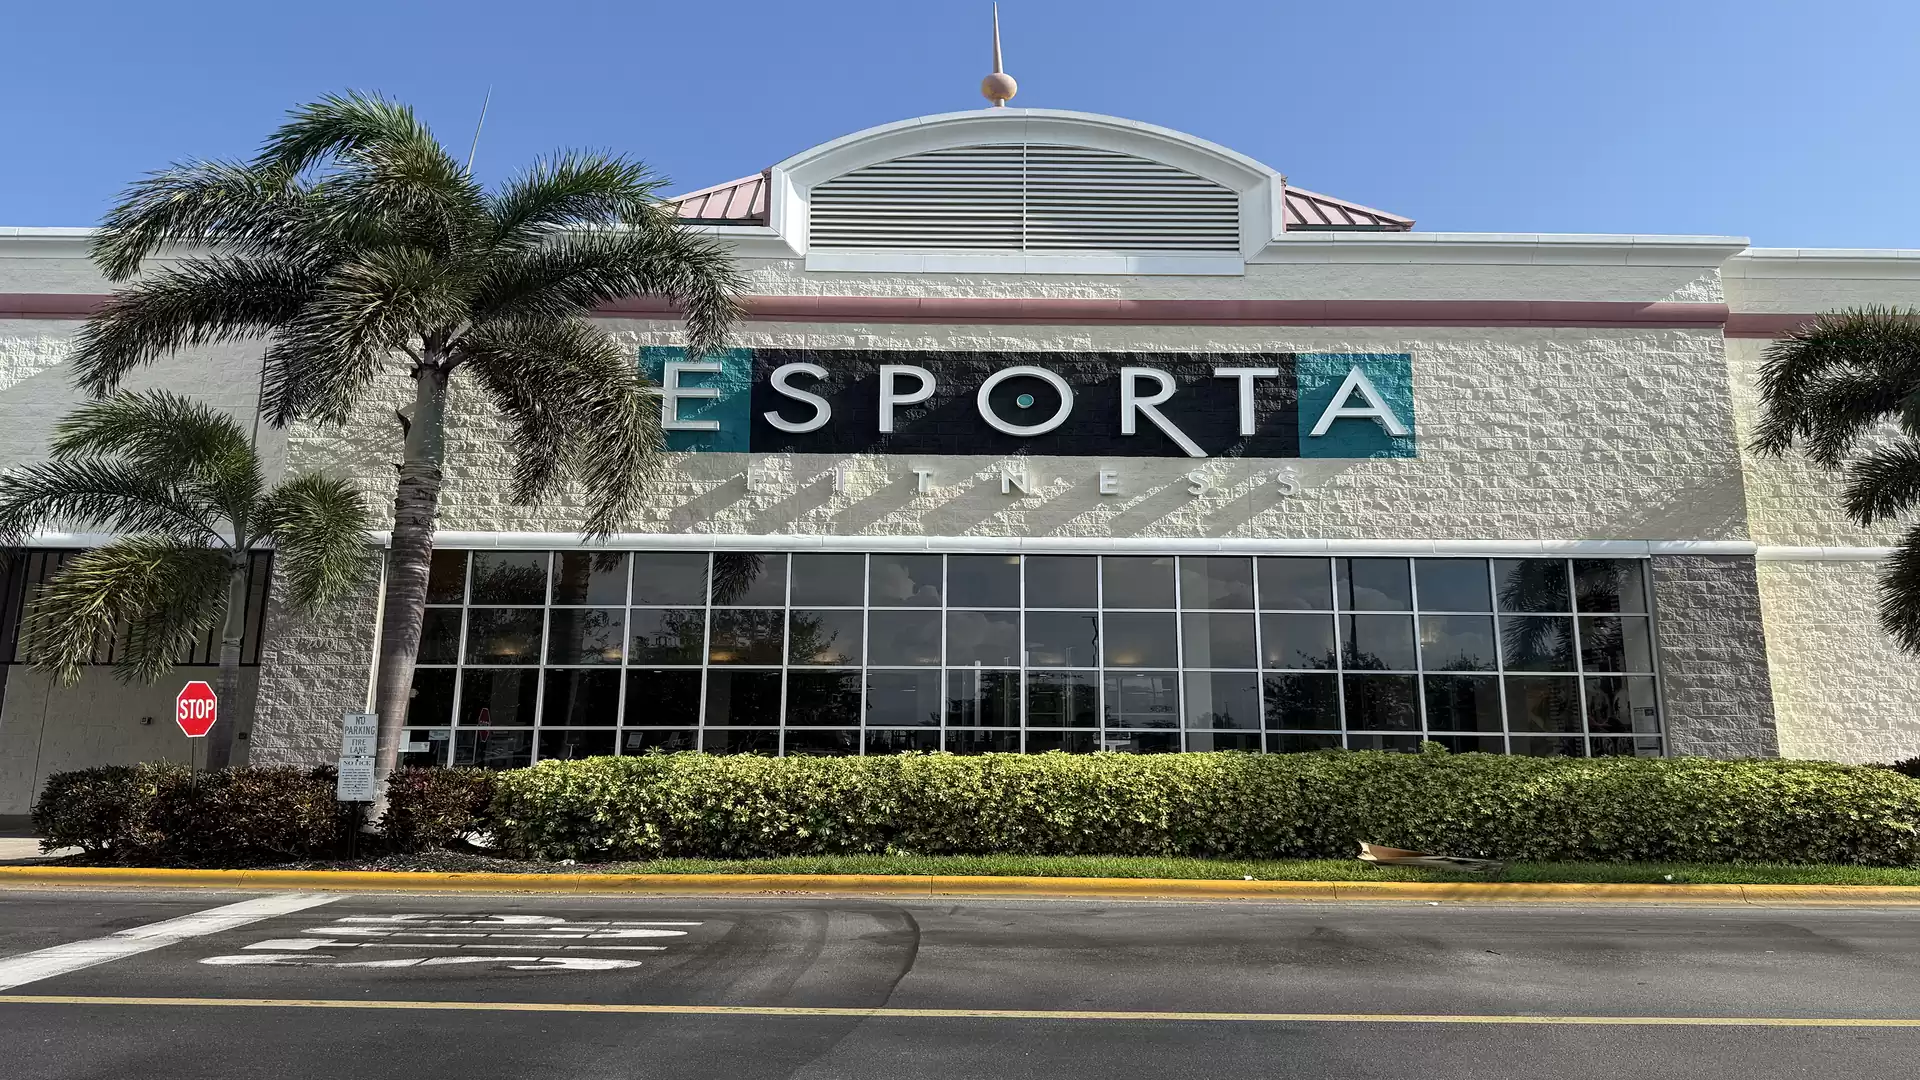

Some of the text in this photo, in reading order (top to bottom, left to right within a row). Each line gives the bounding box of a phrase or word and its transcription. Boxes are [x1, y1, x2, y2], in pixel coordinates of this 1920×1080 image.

[661, 359, 1409, 457] ESPORTA
[747, 467, 1301, 496] FITNESS
[179, 699, 215, 719] STOP
[355, 716, 366, 726] NO
[344, 726, 376, 736] PARKING
[351, 738, 367, 747] FIRE
[349, 746, 368, 754] LANE
